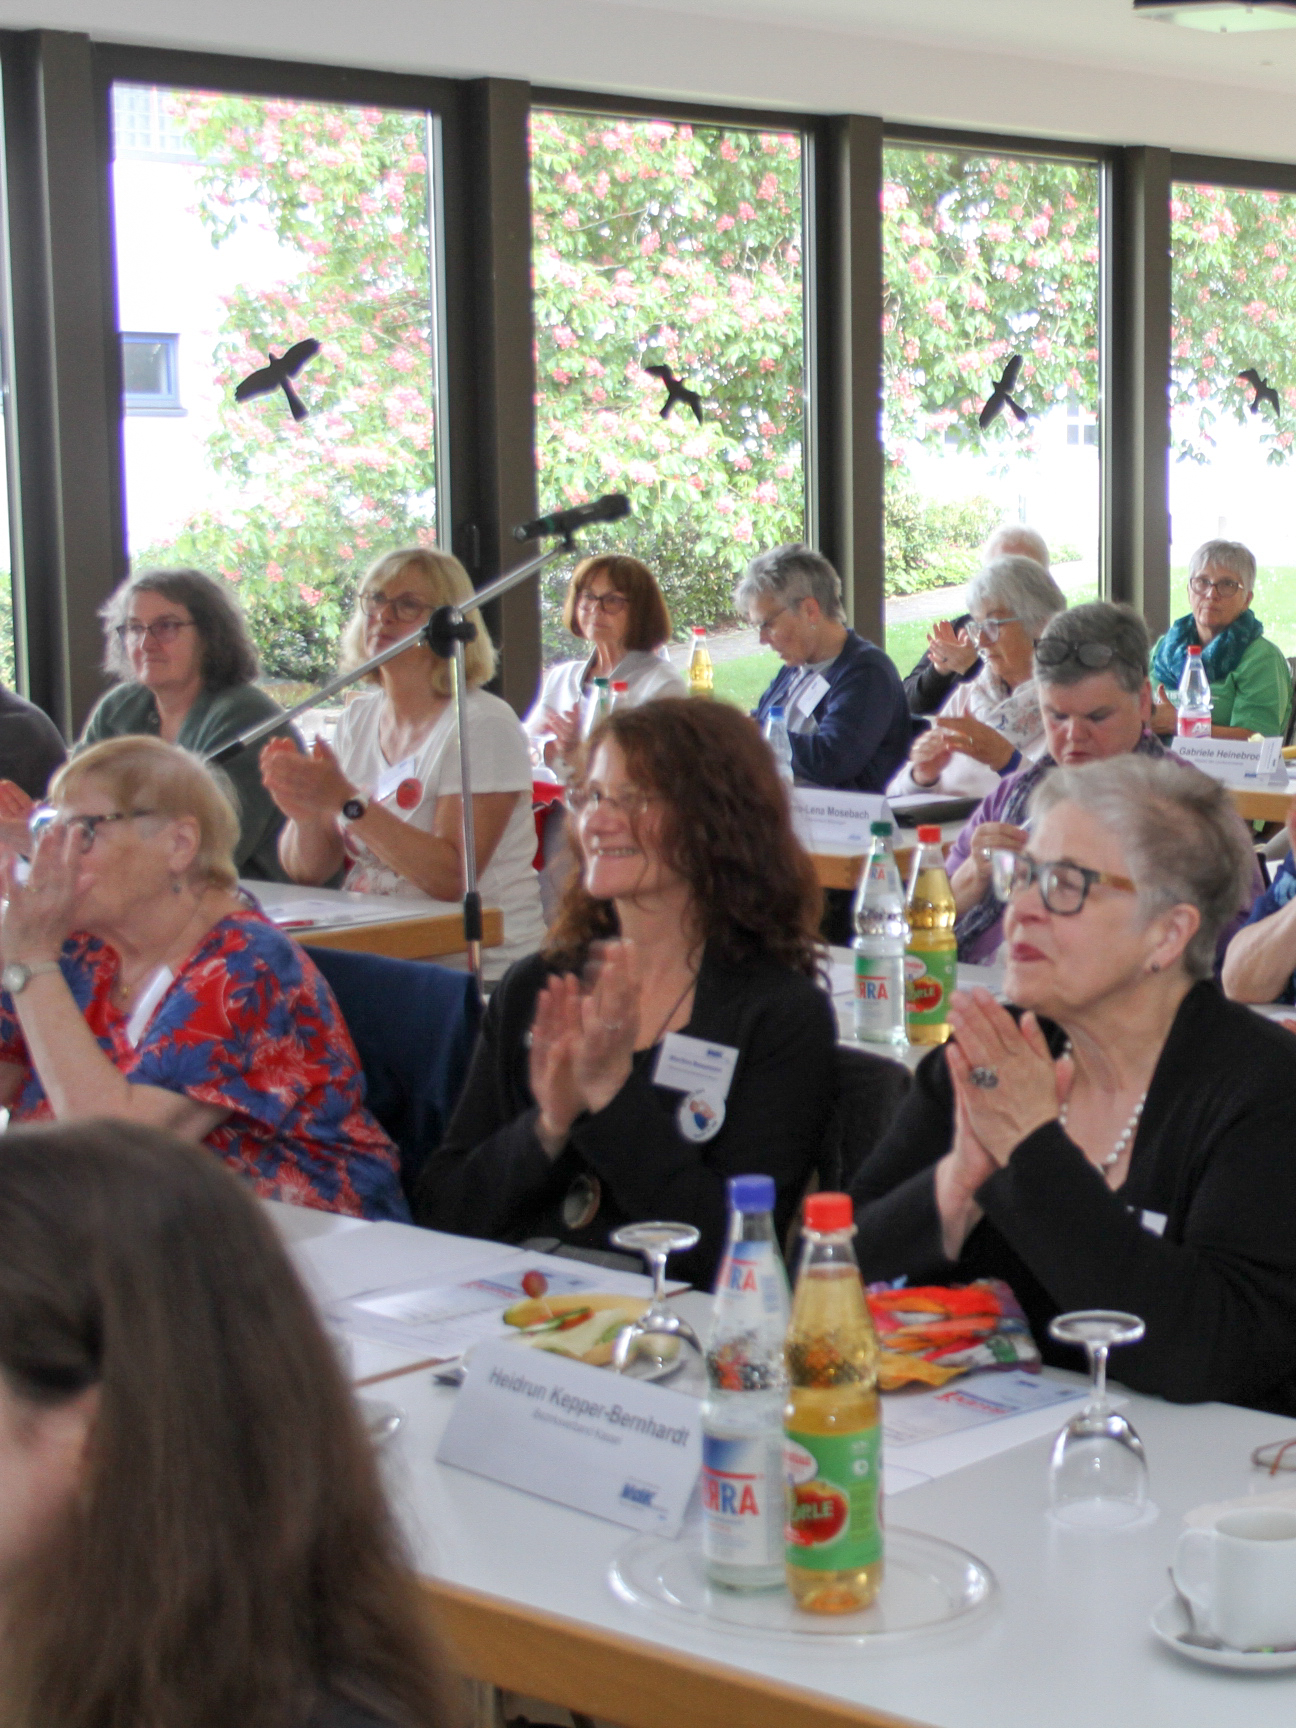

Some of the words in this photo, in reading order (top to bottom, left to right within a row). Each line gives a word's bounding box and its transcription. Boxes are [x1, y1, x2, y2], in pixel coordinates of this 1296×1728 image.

[1179, 746, 1215, 758] Gabriele
[827, 805, 870, 820] Mosebach
[489, 1366, 547, 1400] Heidrun
[550, 1386, 691, 1448] Kepper-Bernhardt
